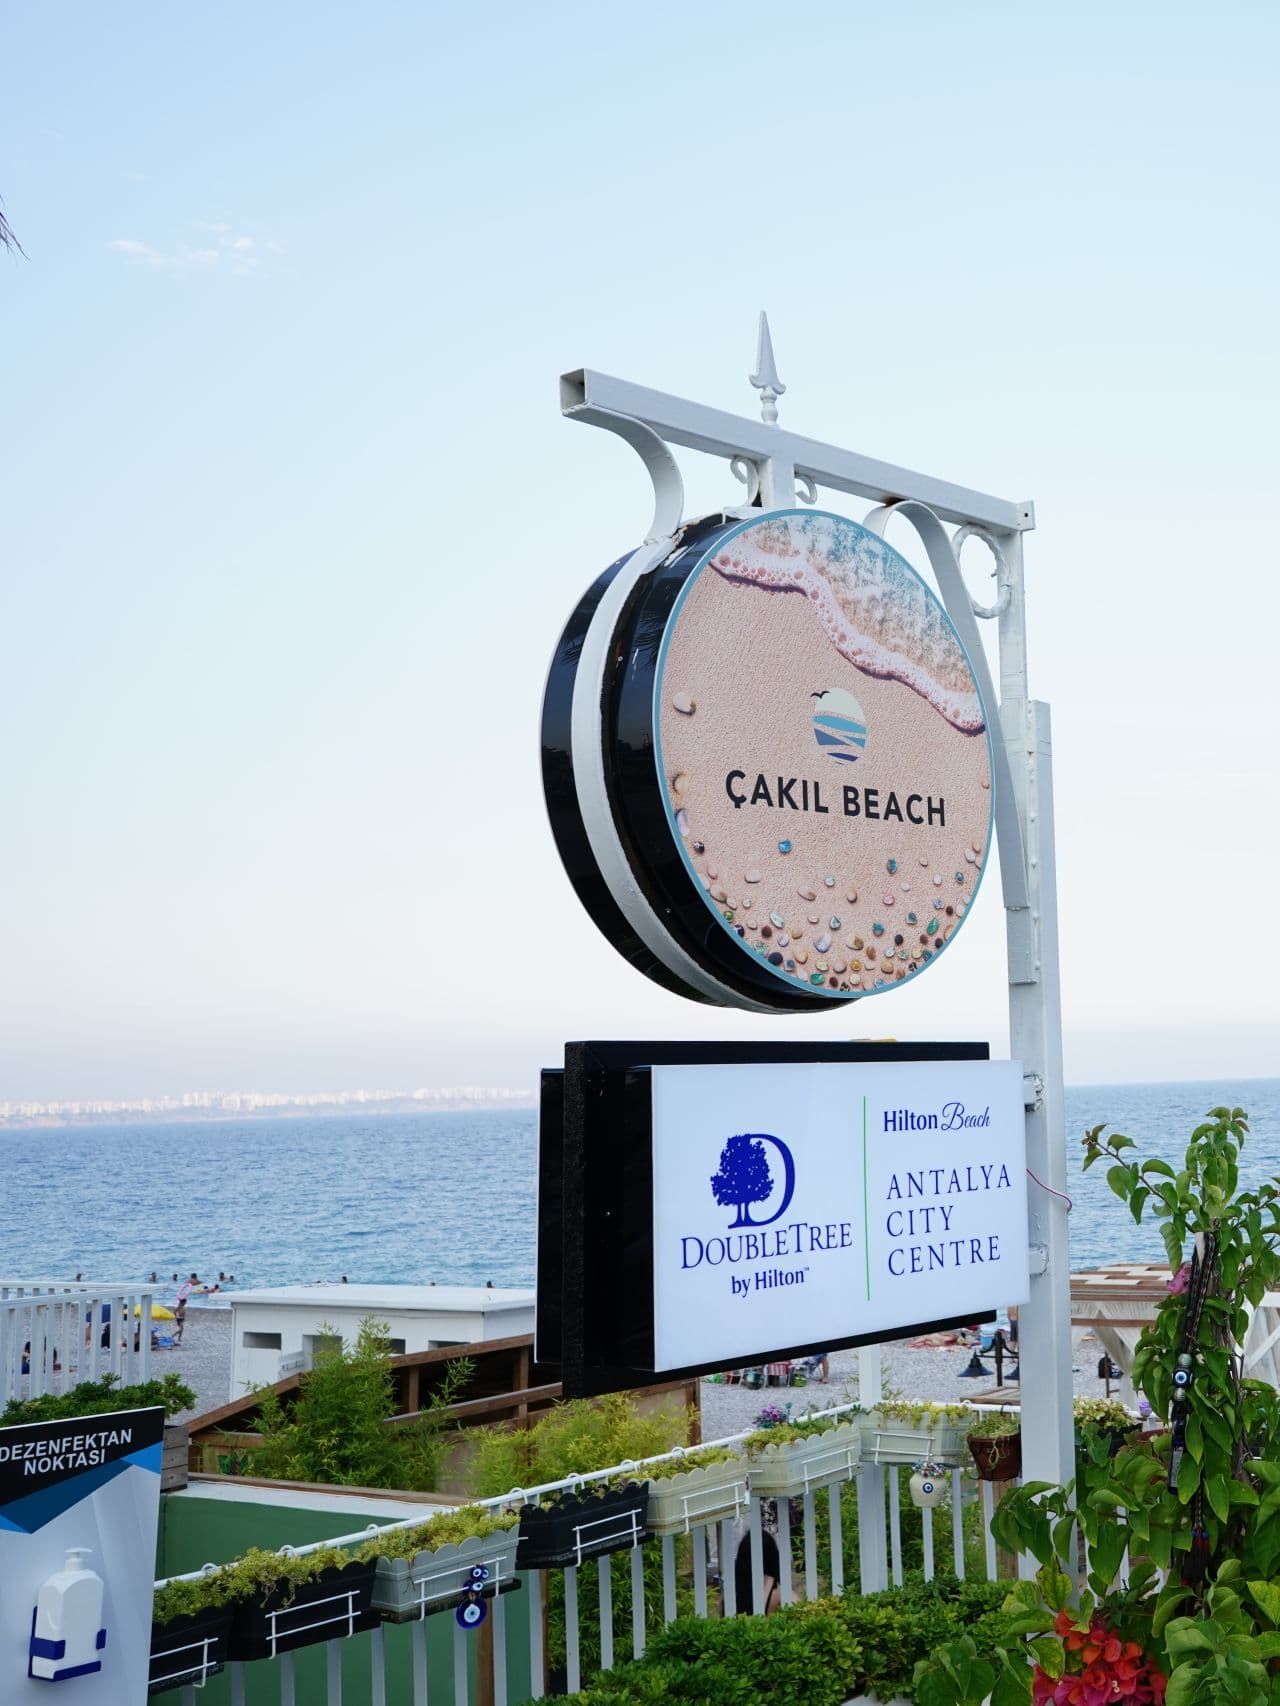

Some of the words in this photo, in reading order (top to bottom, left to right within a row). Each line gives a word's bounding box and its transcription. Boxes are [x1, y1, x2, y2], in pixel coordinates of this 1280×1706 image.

[725, 769, 829, 814] ÇAKIL
[843, 785, 946, 827] BEACH
[883, 1109, 938, 1132] Hilton
[940, 1102, 990, 1131] Beach
[886, 1164, 1012, 1200] ANTALYA
[886, 1205, 955, 1238] CITY
[887, 1235, 1001, 1276] CENTRE
[731, 1275, 752, 1298] by
[0, 1428, 132, 1462] DEZENFEKTAN
[24, 1449, 105, 1476] NOKTASI
